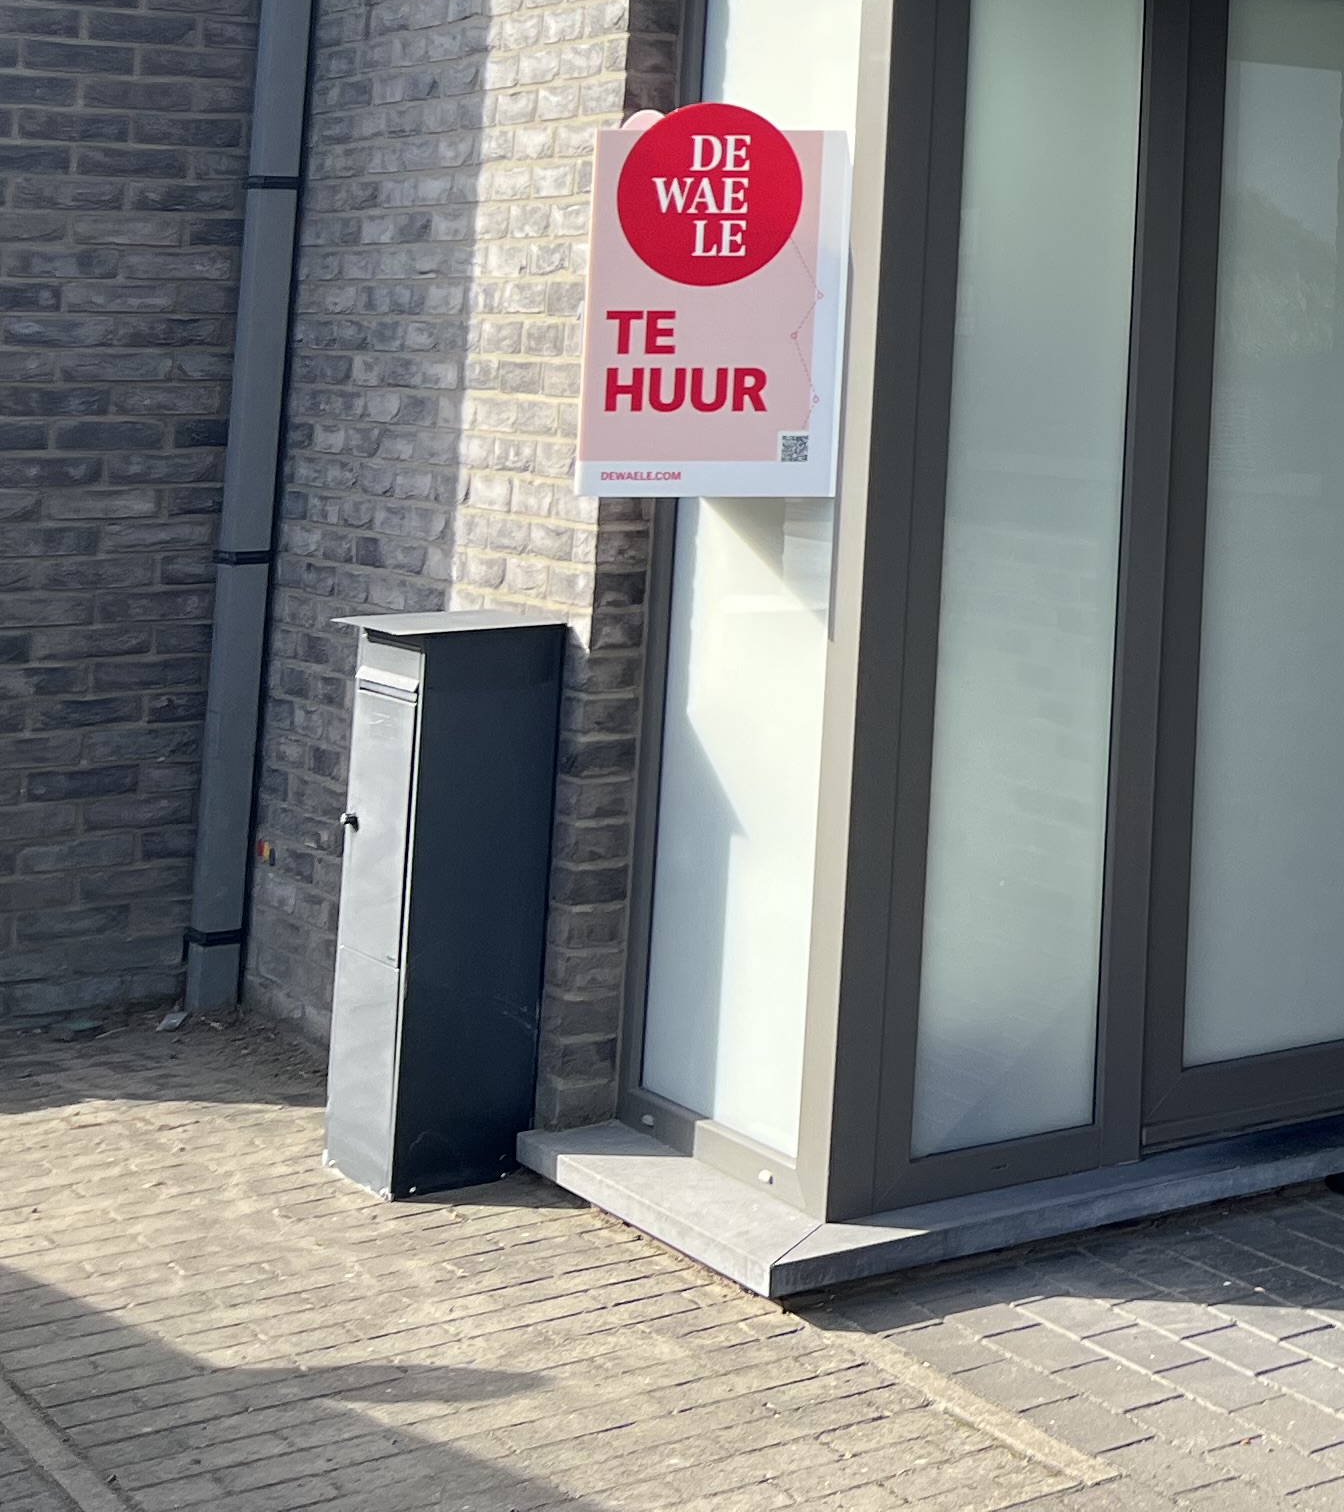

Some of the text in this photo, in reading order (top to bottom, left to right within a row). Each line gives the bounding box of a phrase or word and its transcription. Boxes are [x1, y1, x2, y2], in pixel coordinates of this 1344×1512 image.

[690, 134, 751, 172] DE
[652, 177, 750, 215] WAE
[691, 220, 748, 257] LE
[606, 310, 677, 355] TE
[604, 367, 768, 413] HUUR
[601, 471, 681, 481] DEWAELE.COM
